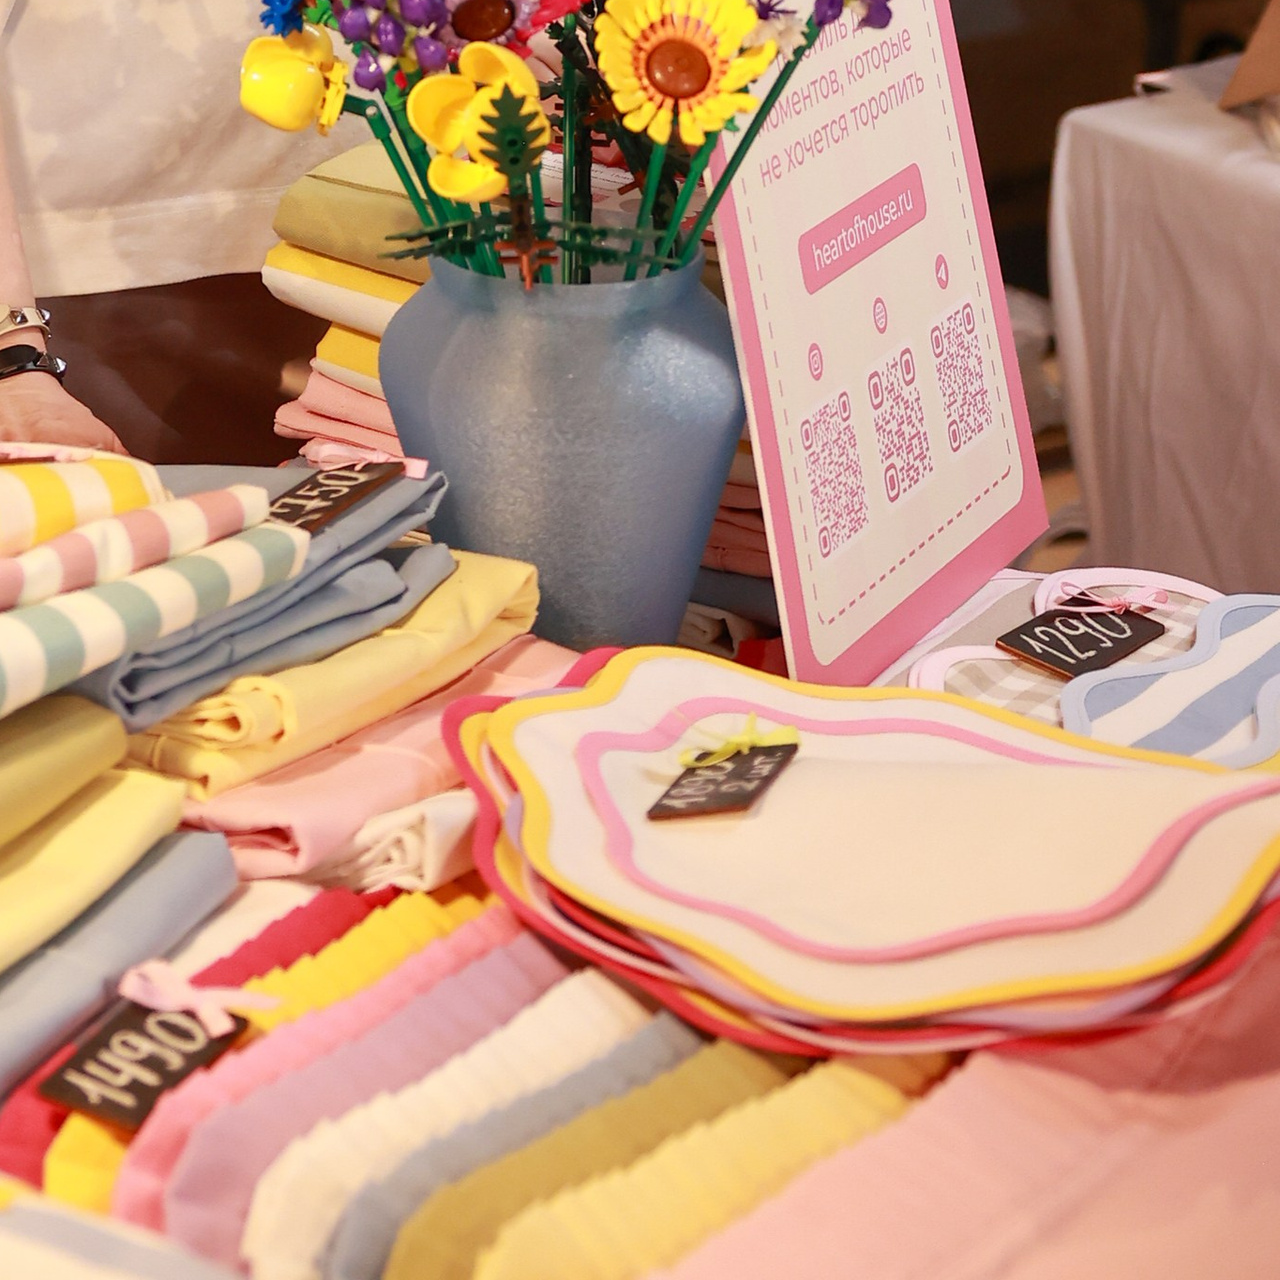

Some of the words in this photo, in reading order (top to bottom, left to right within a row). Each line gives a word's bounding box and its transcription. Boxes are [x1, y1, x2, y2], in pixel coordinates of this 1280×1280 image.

[845, 28, 912, 85] которые
[759, 154, 782, 188] не
[784, 113, 849, 173] хочется
[850, 71, 925, 131] торопить
[812, 189, 914, 271] heartofhouse.ru
[1020, 612, 1133, 664] 1290
[63, 1010, 208, 1110] 1490
